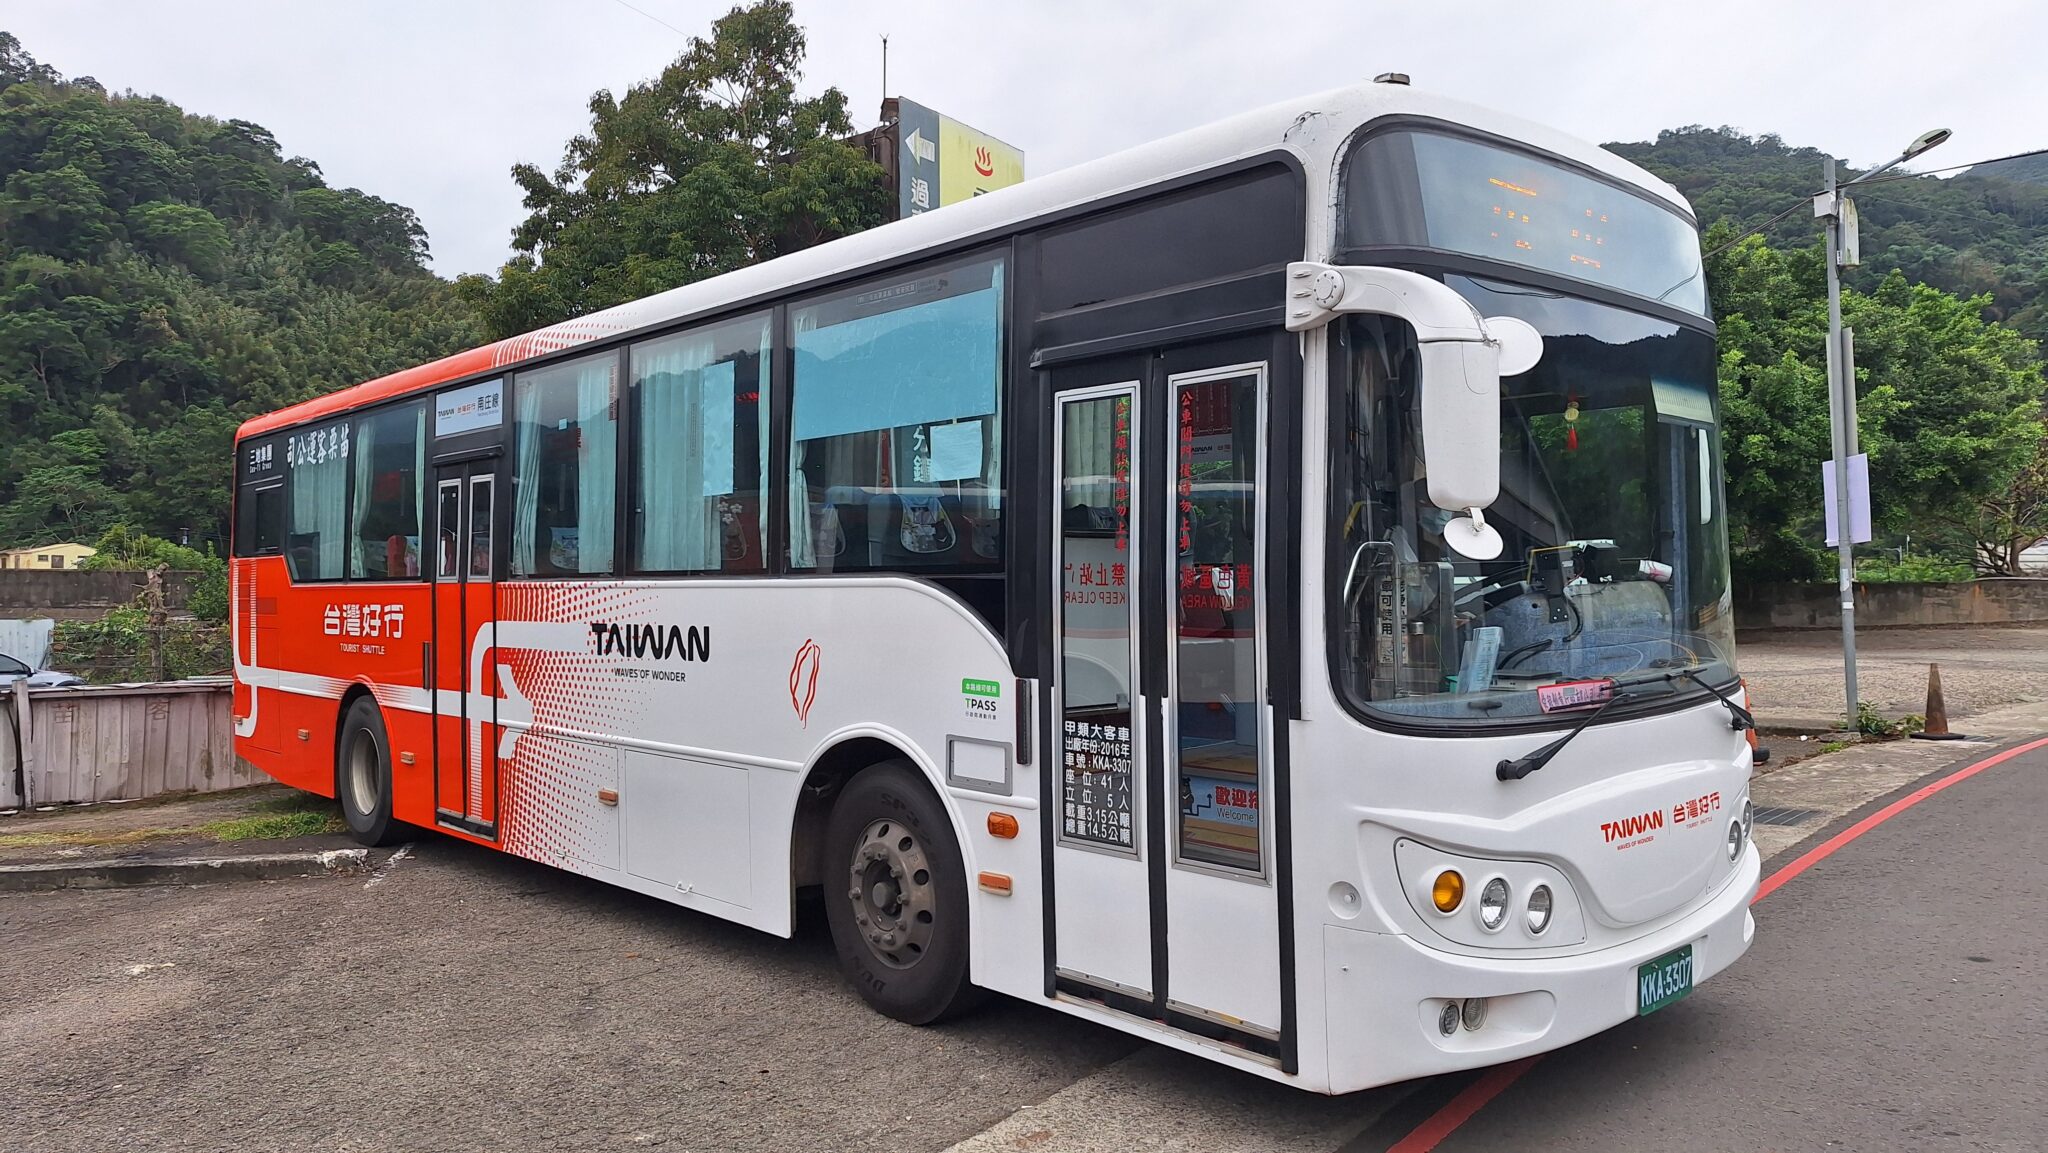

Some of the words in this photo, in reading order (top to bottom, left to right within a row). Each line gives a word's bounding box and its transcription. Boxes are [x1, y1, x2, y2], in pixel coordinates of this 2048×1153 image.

[324, 604, 404, 639] 台灣好行
[340, 643, 360, 653] TOURIST
[362, 644, 385, 655] SHUTTLE
[592, 623, 710, 662] TAIWAN
[614, 668, 638, 679] WAVES
[640, 669, 650, 679] OF
[651, 671, 686, 682] WONDER
[965, 698, 997, 712] TPASS
[1065, 720, 1130, 742] 甲類大客車
[1217, 808, 1254, 822] Welcome
[1673, 791, 1720, 823] 台灣好行
[1601, 809, 1663, 842] TAIWAN
[1617, 842, 1631, 850] WAVES
[1637, 835, 1654, 845] WONDER
